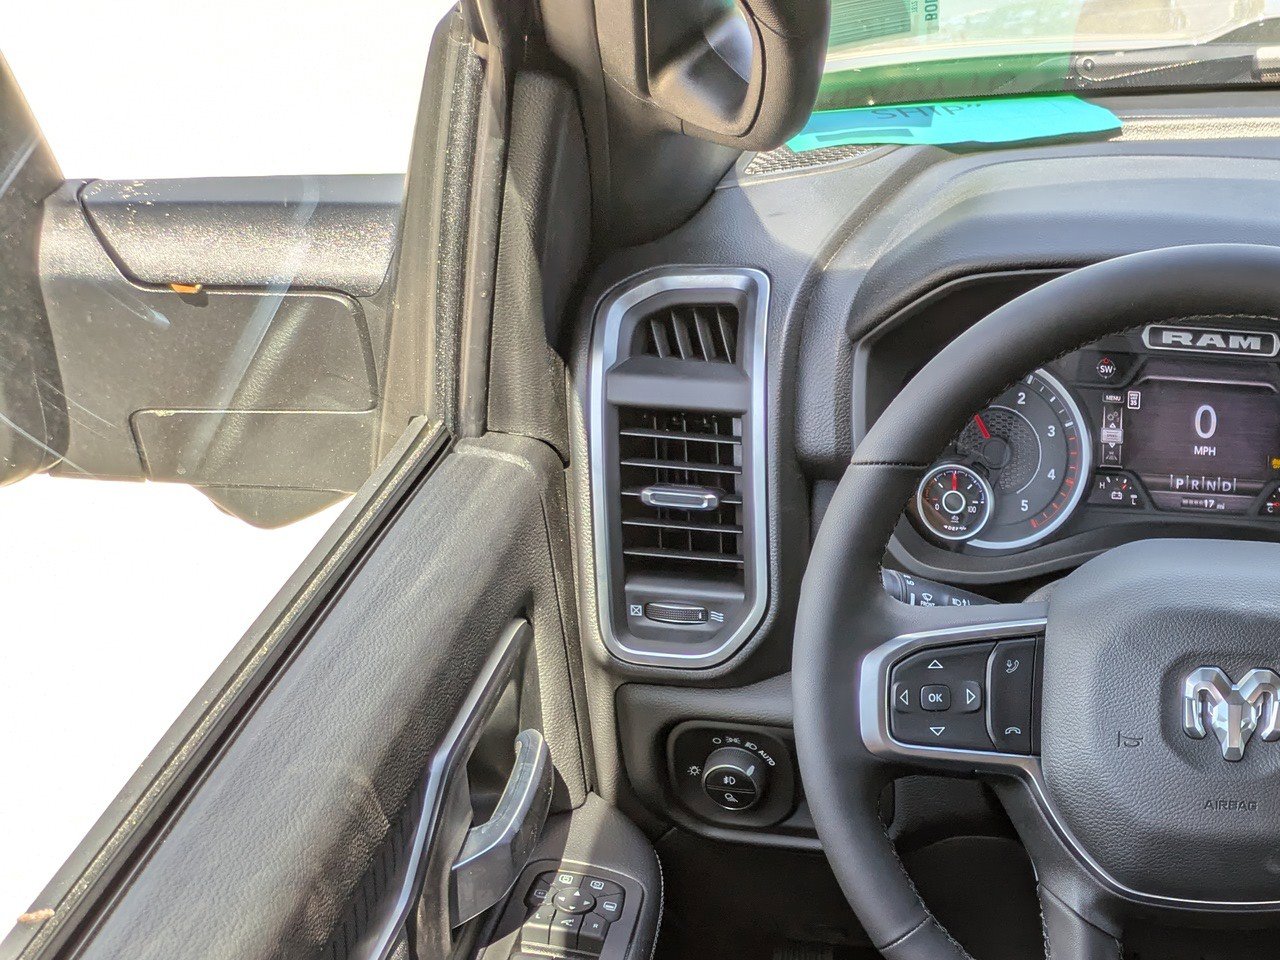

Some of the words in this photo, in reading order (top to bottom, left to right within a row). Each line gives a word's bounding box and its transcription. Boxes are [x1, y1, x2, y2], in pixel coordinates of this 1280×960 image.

[1162, 331, 1261, 350] RAM
[1100, 365, 1113, 374] SW
[1018, 393, 1026, 405] 2
[1194, 404, 1218, 439] 0
[1047, 426, 1056, 437] 3
[1194, 446, 1216, 456] MPH
[1047, 468, 1056, 480] 4
[967, 505, 977, 514] 100
[1020, 500, 1029, 512] 5
[928, 692, 943, 704] OK
[758, 750, 776, 766] AUTO
[1203, 800, 1258, 812] AIRBAG
